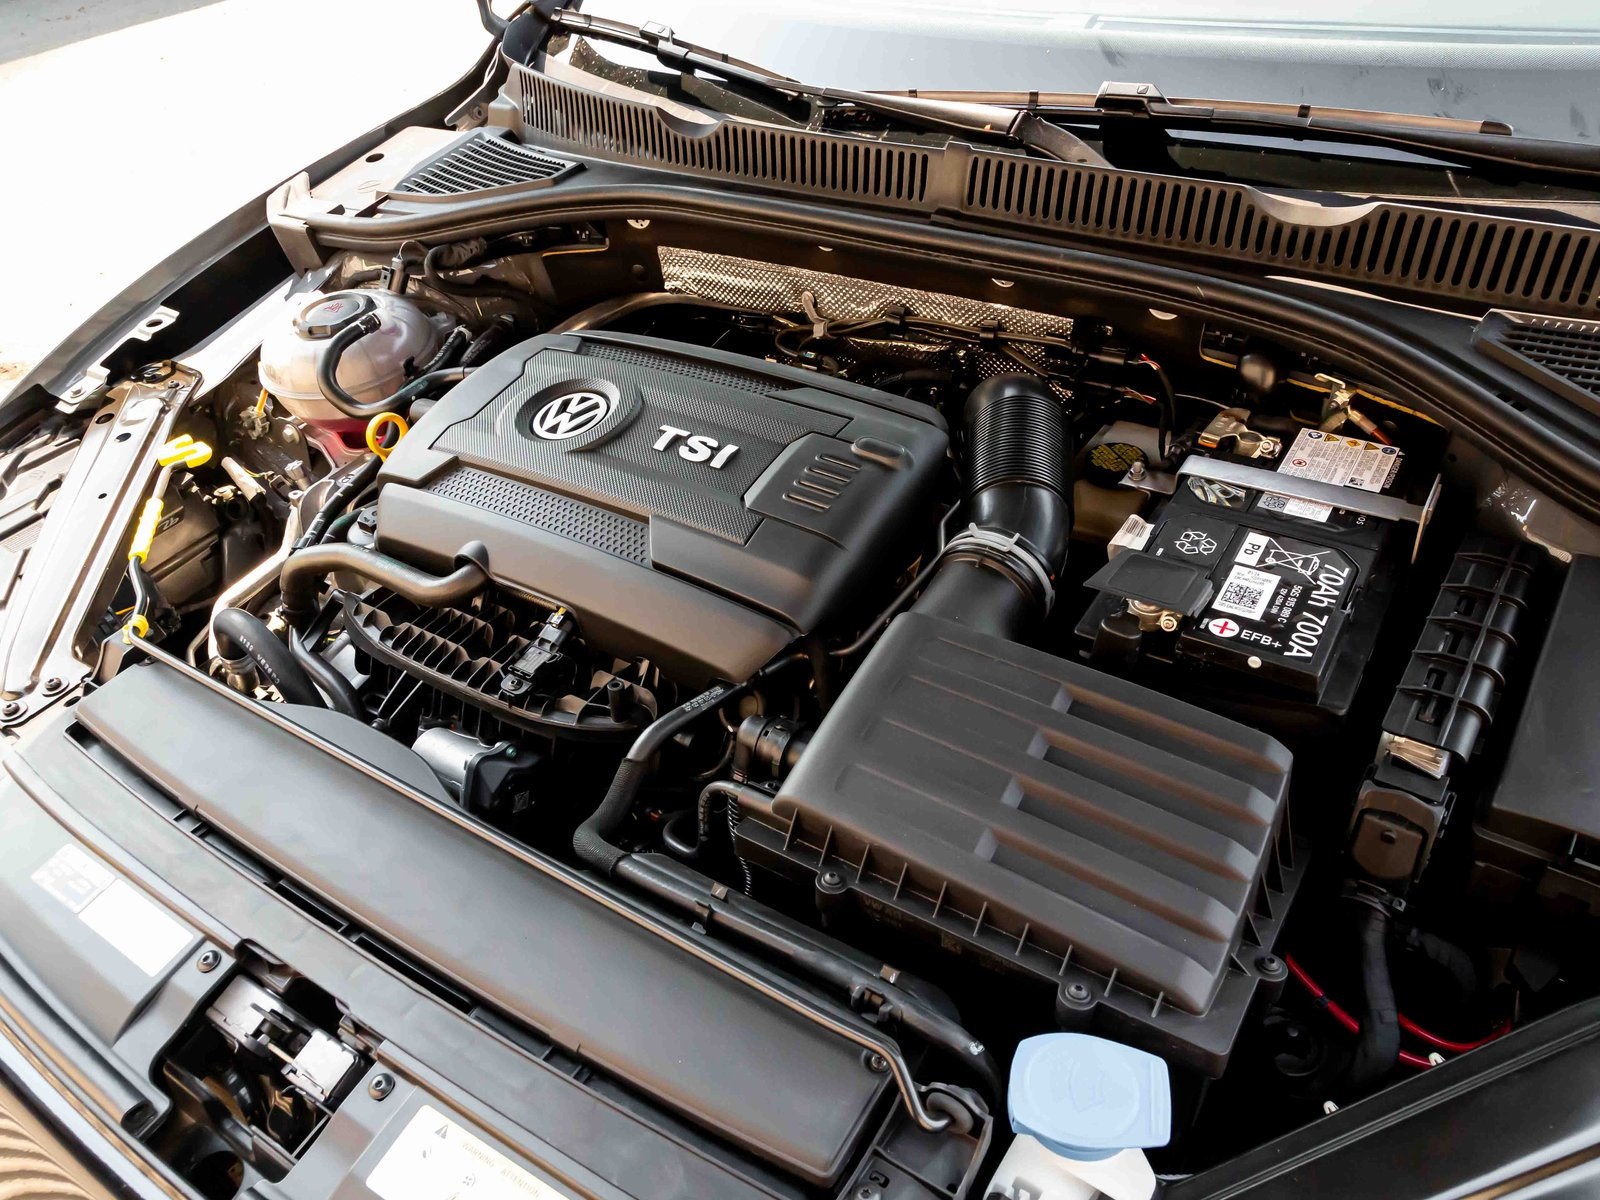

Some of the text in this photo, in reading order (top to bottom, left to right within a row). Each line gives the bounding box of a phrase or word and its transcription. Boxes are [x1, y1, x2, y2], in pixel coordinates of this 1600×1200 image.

[651, 424, 740, 469] TSI
[1244, 542, 1261, 556] Pb
[1283, 564, 1350, 658] 70Ah 700A
[1285, 597, 1297, 607] 915
[1240, 629, 1282, 648] EFB+
[462, 1142, 541, 1198] WARNING ATTENTION
